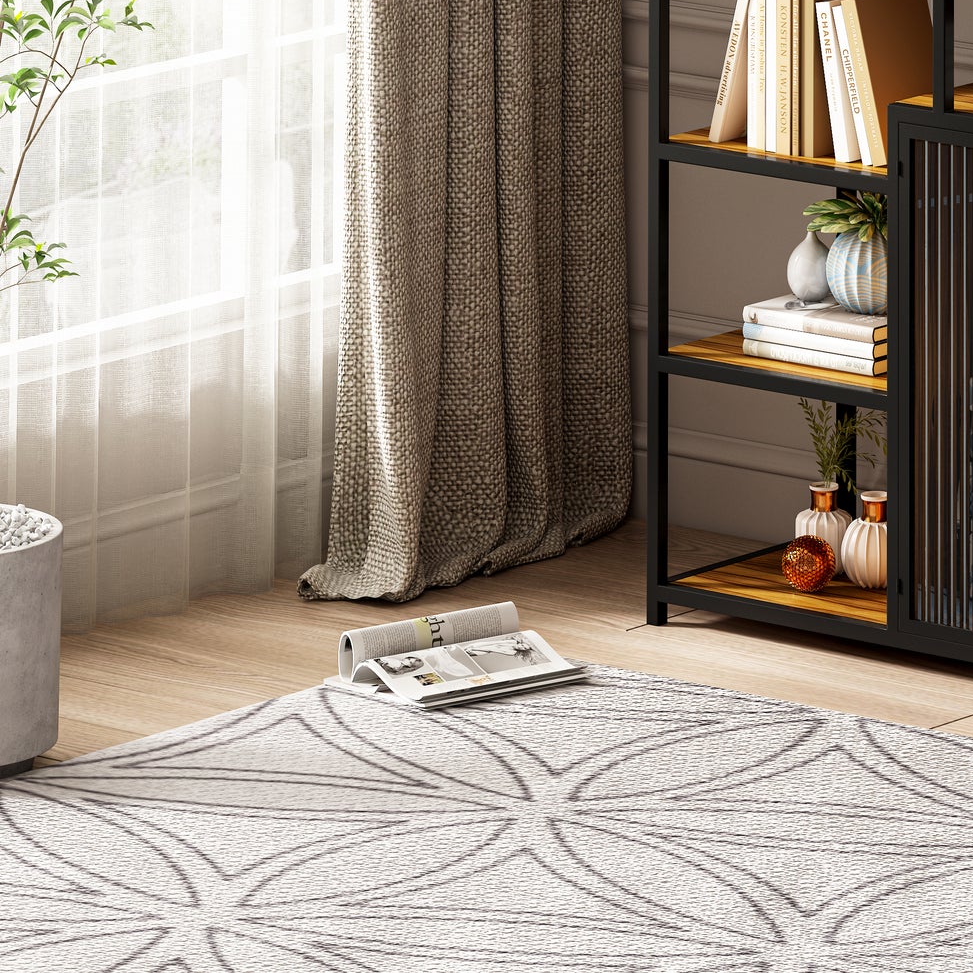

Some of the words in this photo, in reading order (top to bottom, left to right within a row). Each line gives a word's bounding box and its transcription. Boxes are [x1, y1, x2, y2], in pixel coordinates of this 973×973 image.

[819, 11, 833, 63] CHANEL
[716, 60, 731, 106] advertising
[842, 49, 860, 115] CHIPPERFIELD
